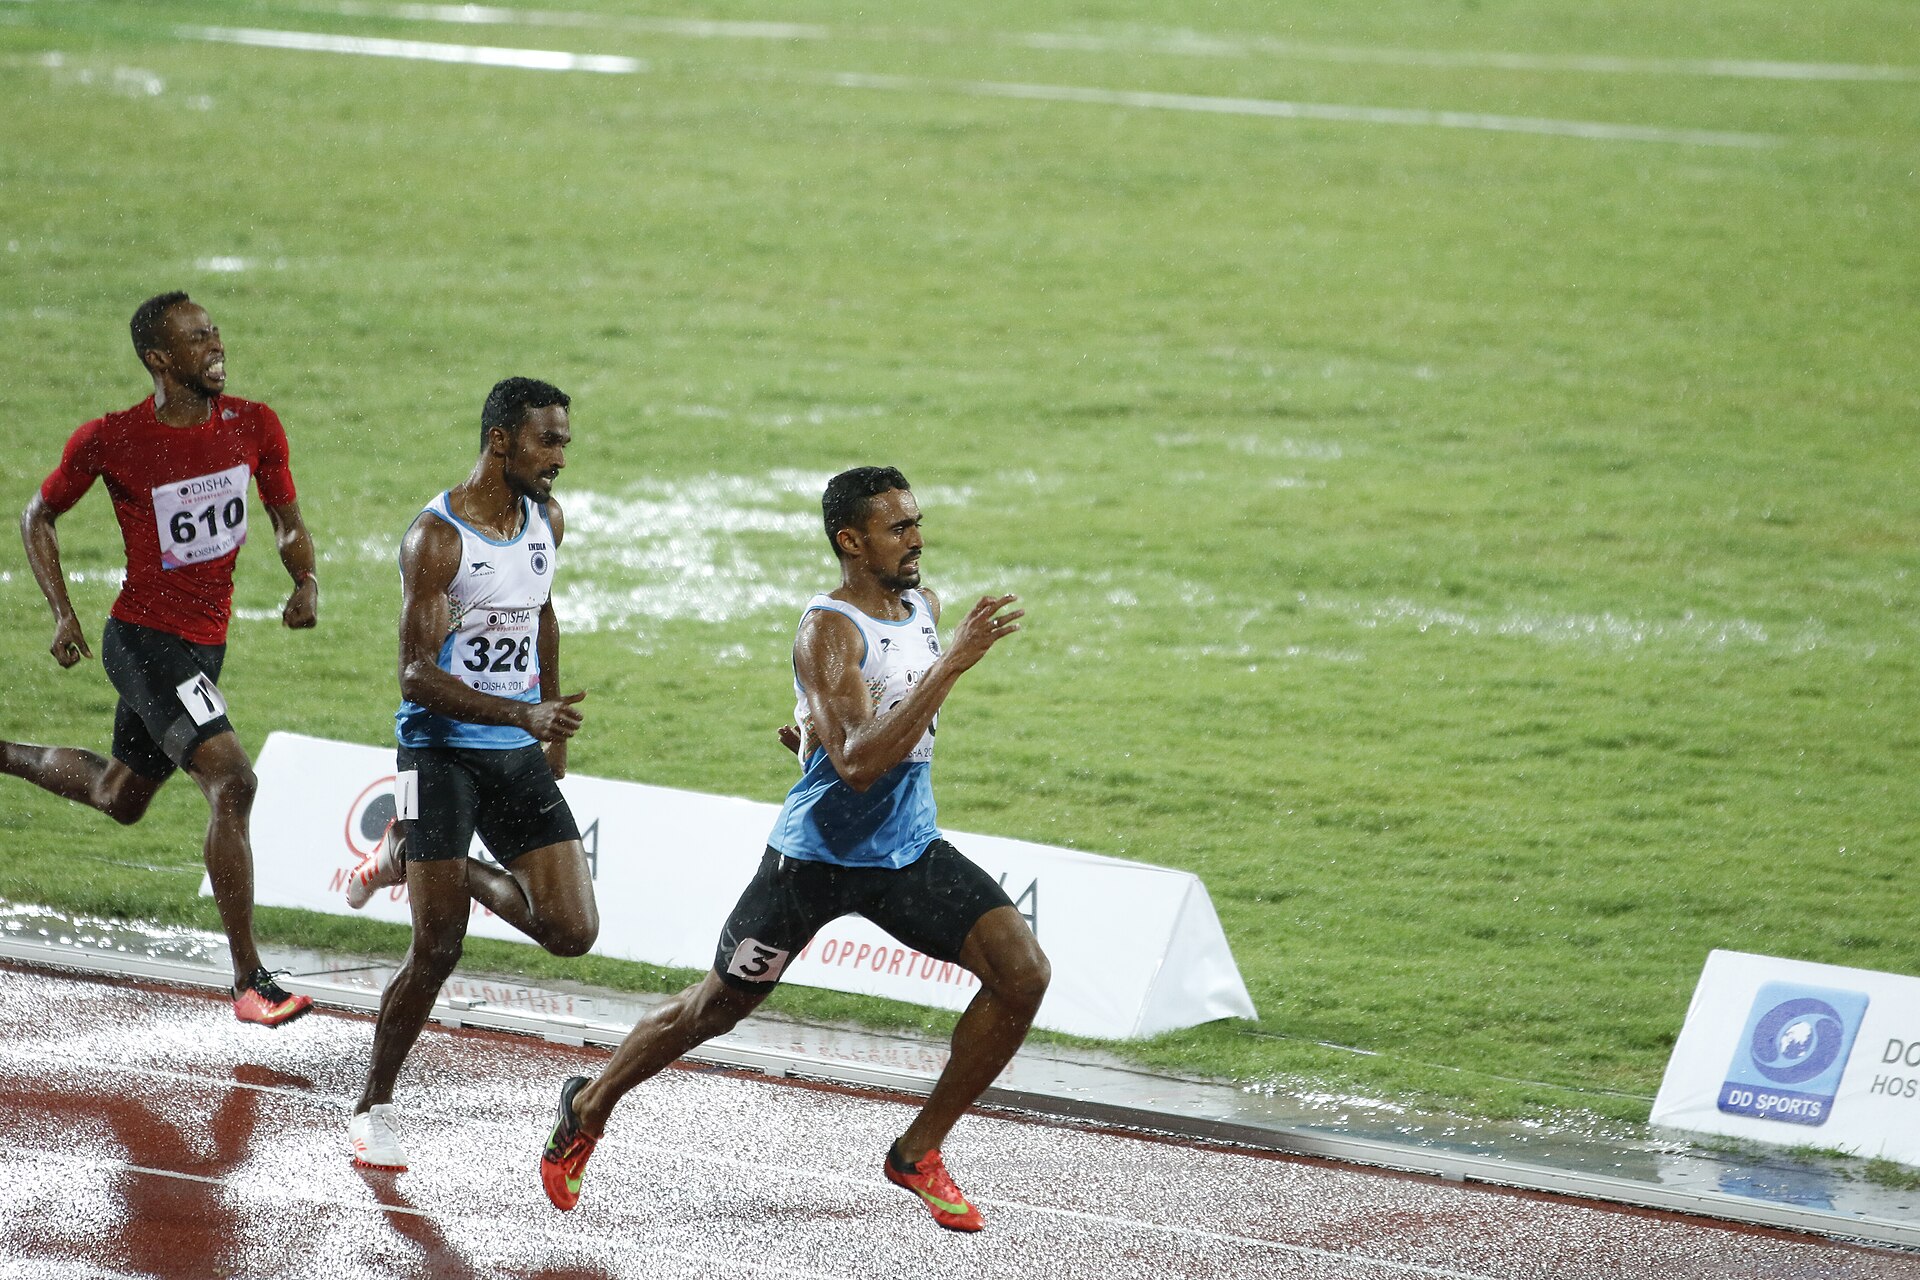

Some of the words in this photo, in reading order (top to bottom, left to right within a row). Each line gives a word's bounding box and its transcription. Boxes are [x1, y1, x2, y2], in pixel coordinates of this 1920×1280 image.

[177, 476, 232, 499] ODISHA
[169, 497, 244, 544] 610
[528, 543, 547, 551] INDIA
[487, 611, 531, 626] ODISHA
[463, 636, 531, 672] 328
[193, 677, 216, 713] 1
[472, 680, 507, 692] ODISHA
[739, 945, 778, 976] 3
[1728, 1090, 1753, 1107] DD
[1755, 1094, 1822, 1117] SPORTS
